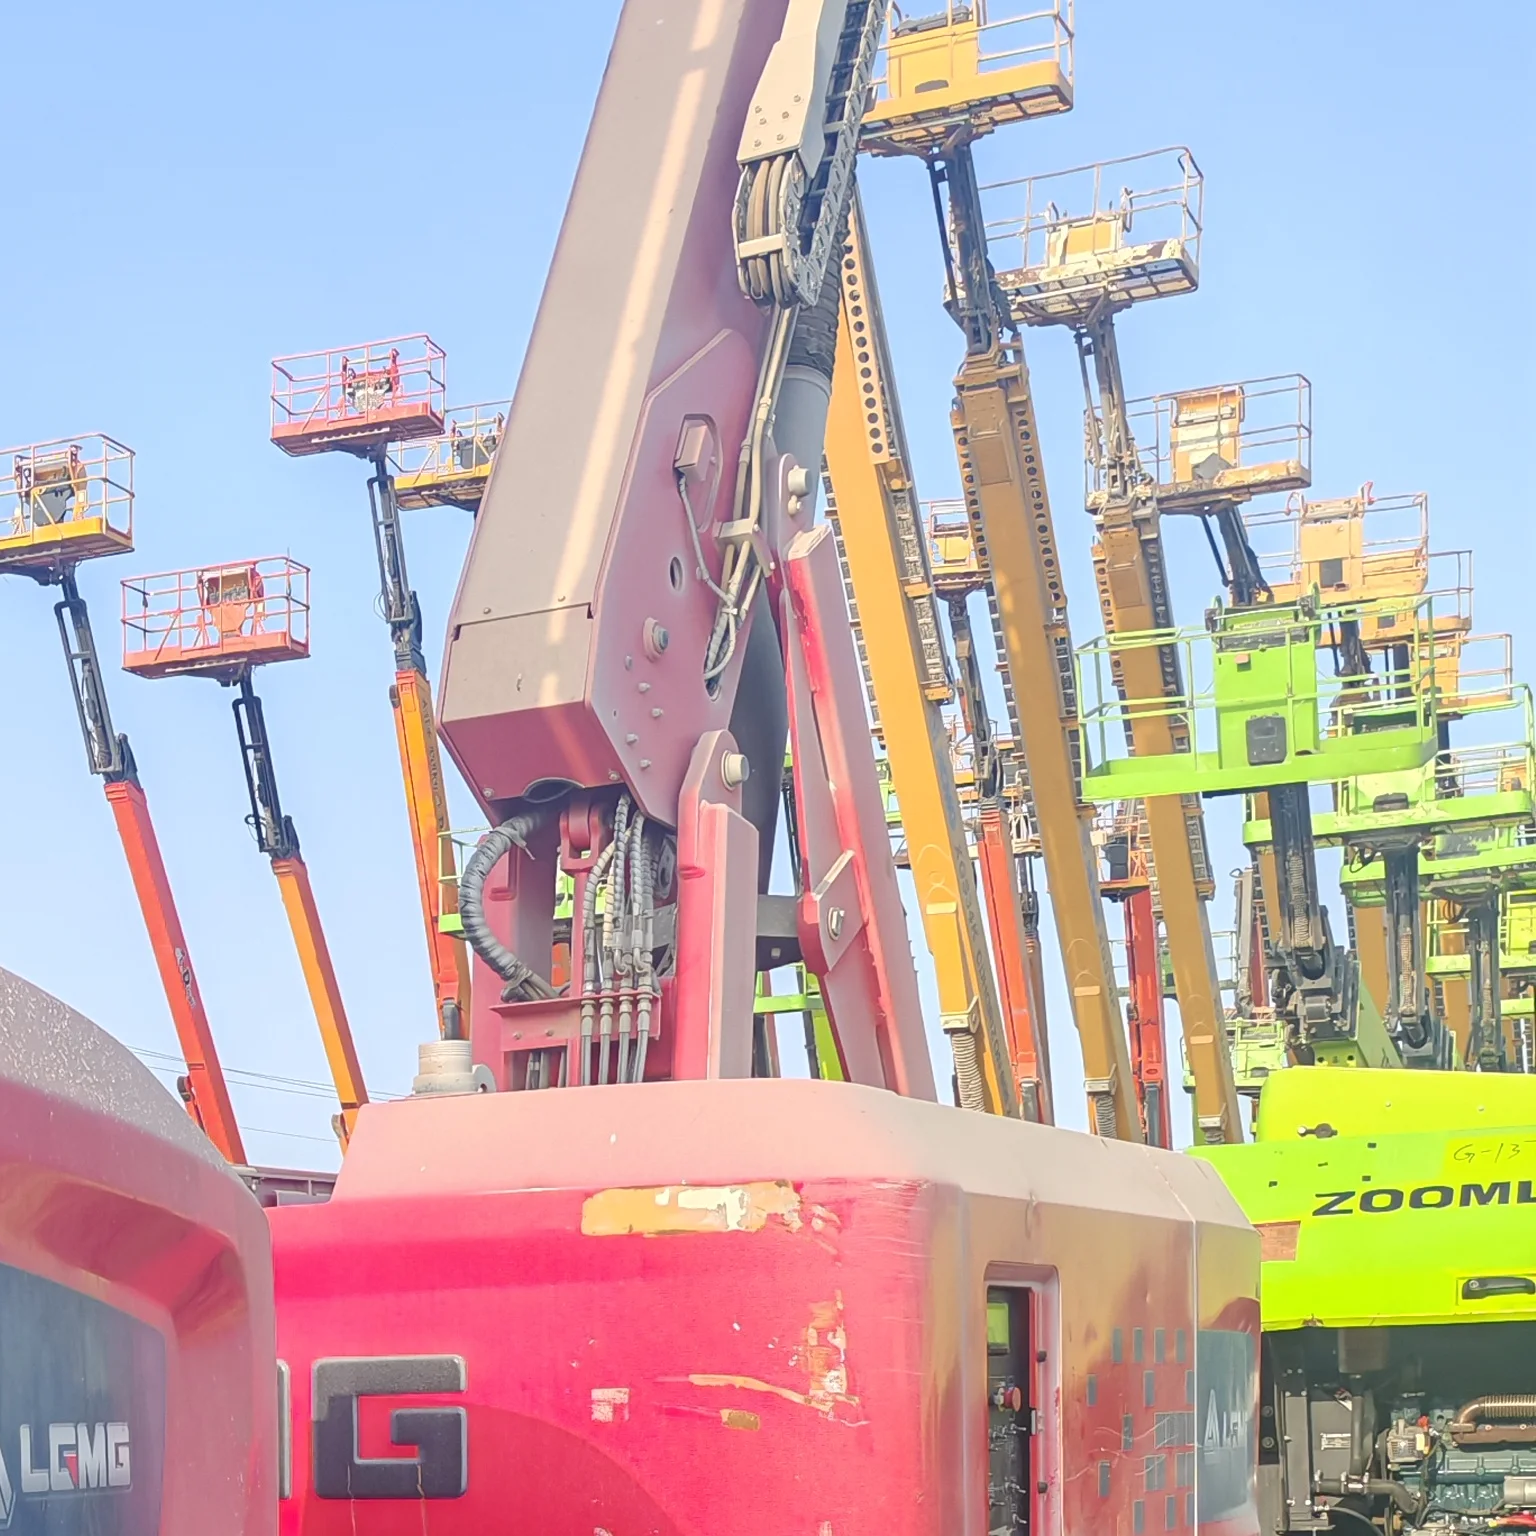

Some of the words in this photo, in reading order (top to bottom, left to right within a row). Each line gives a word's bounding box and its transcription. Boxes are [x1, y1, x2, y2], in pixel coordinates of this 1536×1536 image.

[1453, 1139, 1536, 1164] G-13
[1312, 1180, 1536, 1217] ZOOML
[277, 1355, 467, 1499] G
[20, 1421, 131, 1493] LGMG
